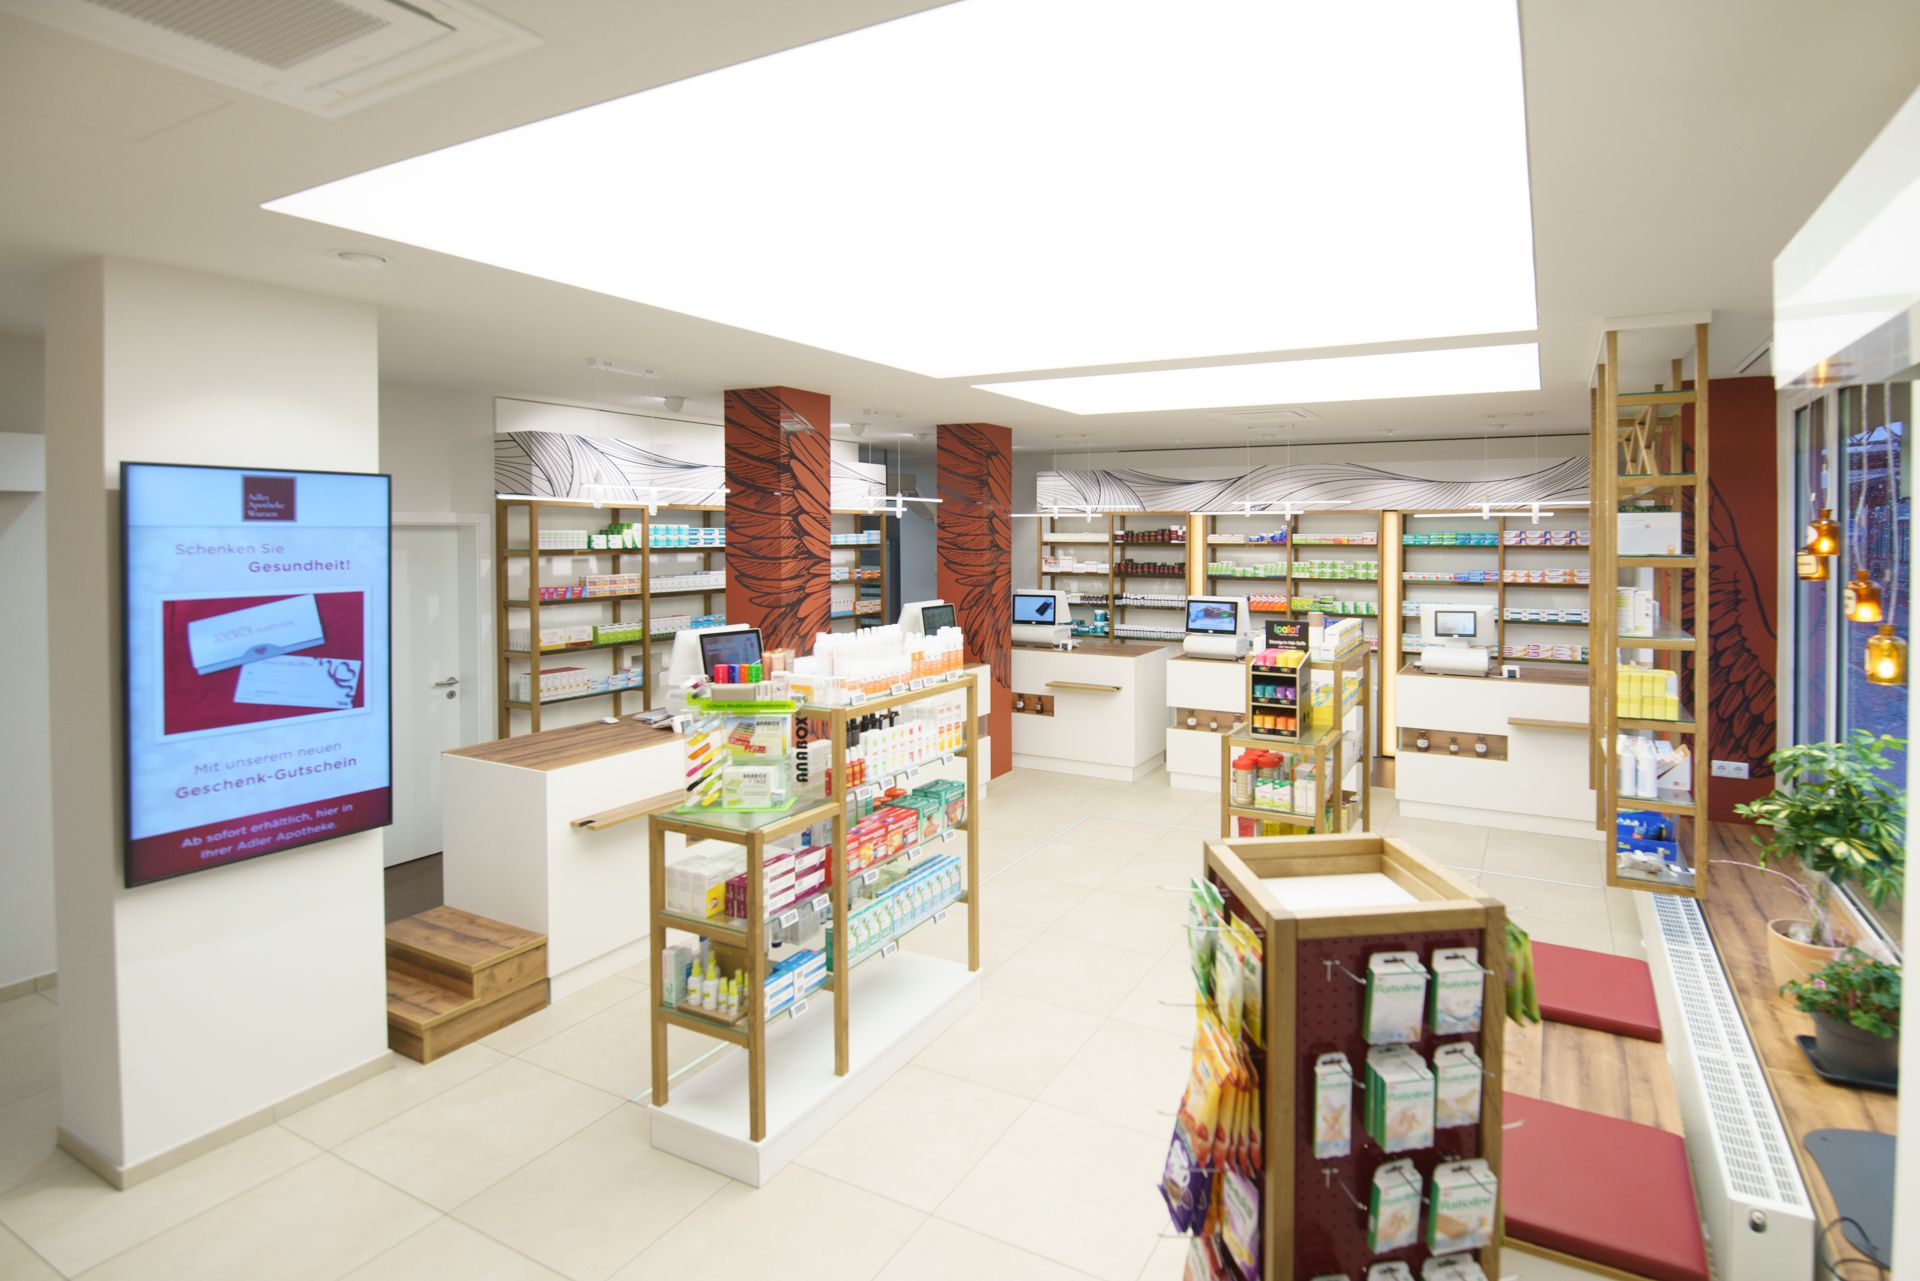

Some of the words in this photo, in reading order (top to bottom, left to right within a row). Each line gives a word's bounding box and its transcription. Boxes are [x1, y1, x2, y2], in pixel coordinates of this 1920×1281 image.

[175, 543, 256, 555] Schenken
[261, 543, 285, 554] Sie
[248, 560, 351, 573] Gesundheit!
[194, 763, 219, 775] Mit
[225, 751, 292, 770] unserem
[297, 742, 342, 757] neuen
[795, 717, 809, 783] ANABOX
[175, 757, 357, 799] Geschenk-Gutschein
[181, 836, 203, 848] Ab
[206, 826, 247, 843] sofort
[251, 812, 313, 832] erhältlich,
[315, 807, 339, 818] hier
[342, 803, 353, 812] in
[201, 846, 232, 859] Ihrer
[237, 837, 273, 851] Adler
[276, 821, 338, 842] Apotheke.
